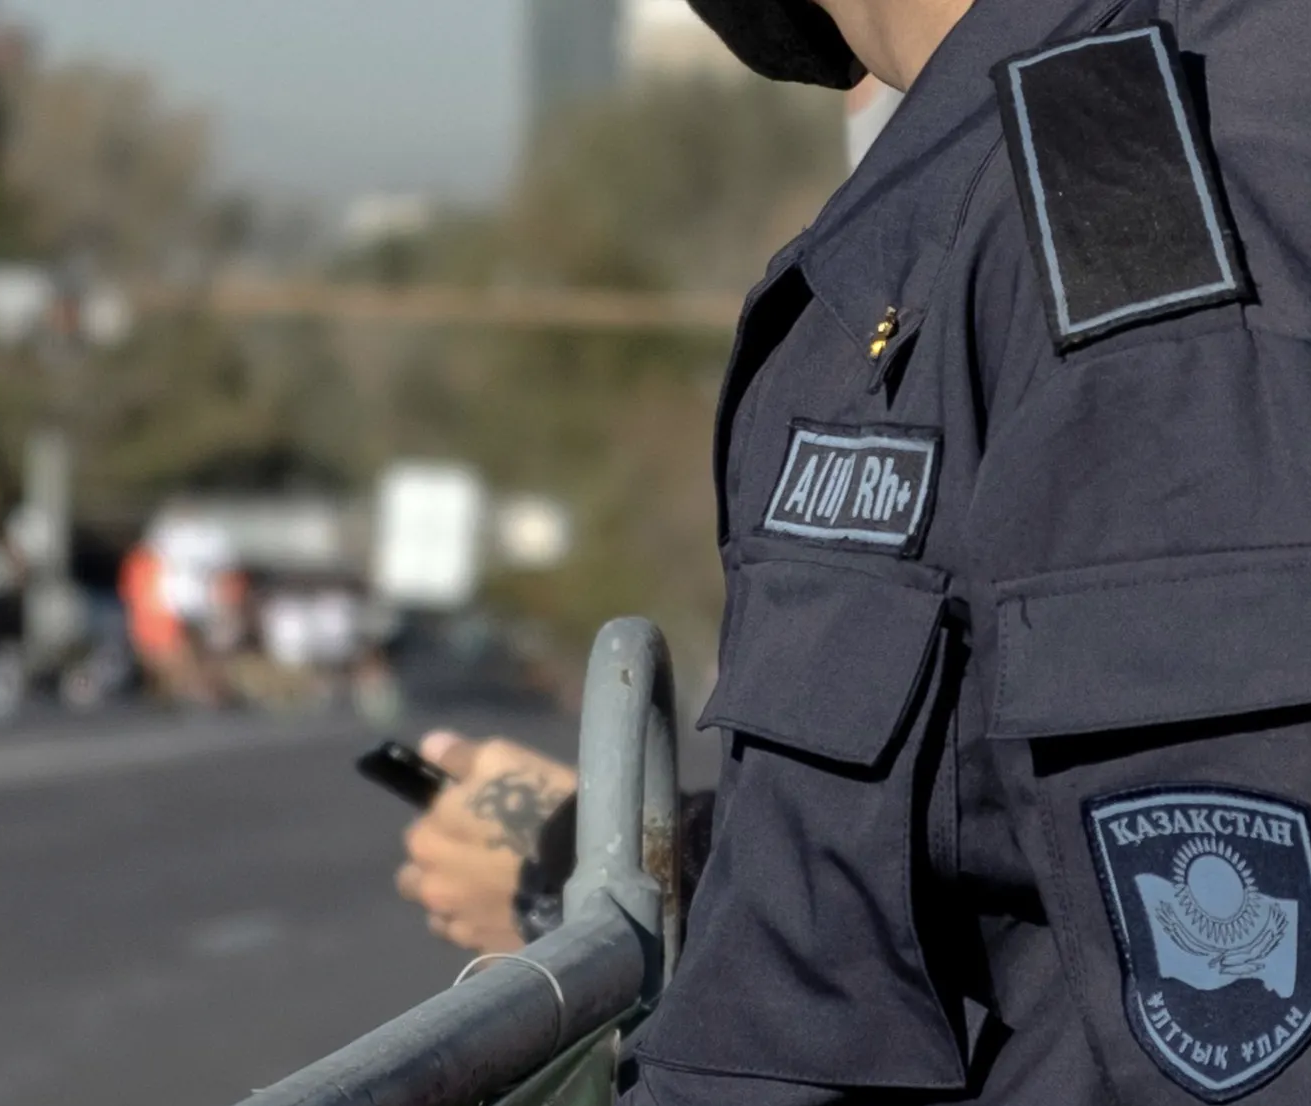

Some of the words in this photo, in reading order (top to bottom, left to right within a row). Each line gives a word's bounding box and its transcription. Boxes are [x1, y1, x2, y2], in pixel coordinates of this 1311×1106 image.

[852, 456, 911, 520] Rh+
[1109, 808, 1294, 847] ҚАЗАҚСТАН
[1147, 992, 1229, 1070] ҰЛТТЫҚ
[1242, 1007, 1304, 1062] ҰЛАН
